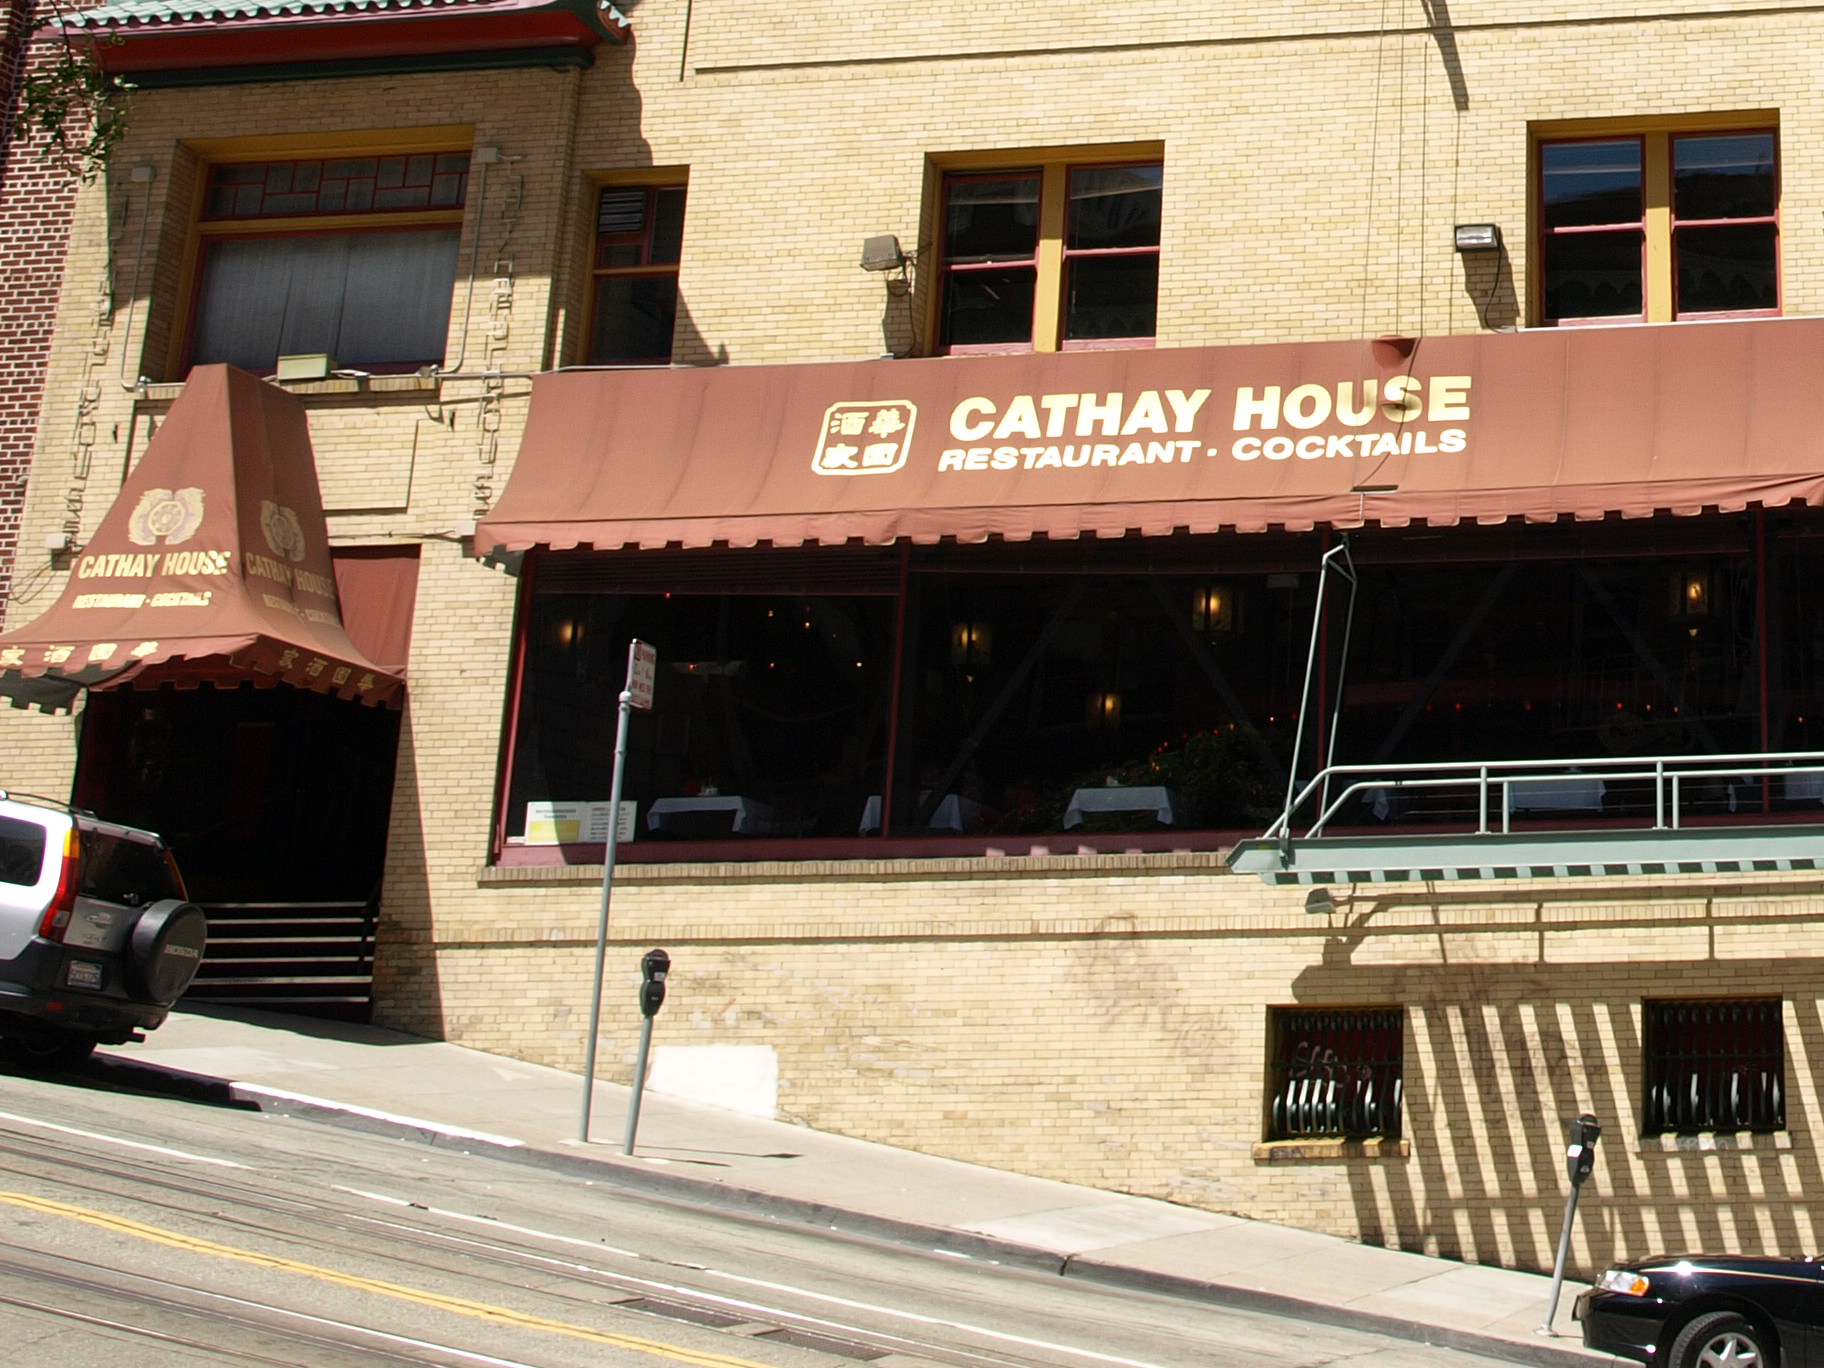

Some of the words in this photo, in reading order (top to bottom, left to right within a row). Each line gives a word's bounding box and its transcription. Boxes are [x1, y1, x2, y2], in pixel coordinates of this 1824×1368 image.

[949, 389, 1212, 442] CATHAY
[1232, 375, 1472, 432] HOUSE
[937, 440, 1202, 472] RESTAURANT
[1231, 428, 1467, 461] COCKTAILS
[77, 553, 161, 580] CATHAY
[162, 550, 232, 577] HOUSE
